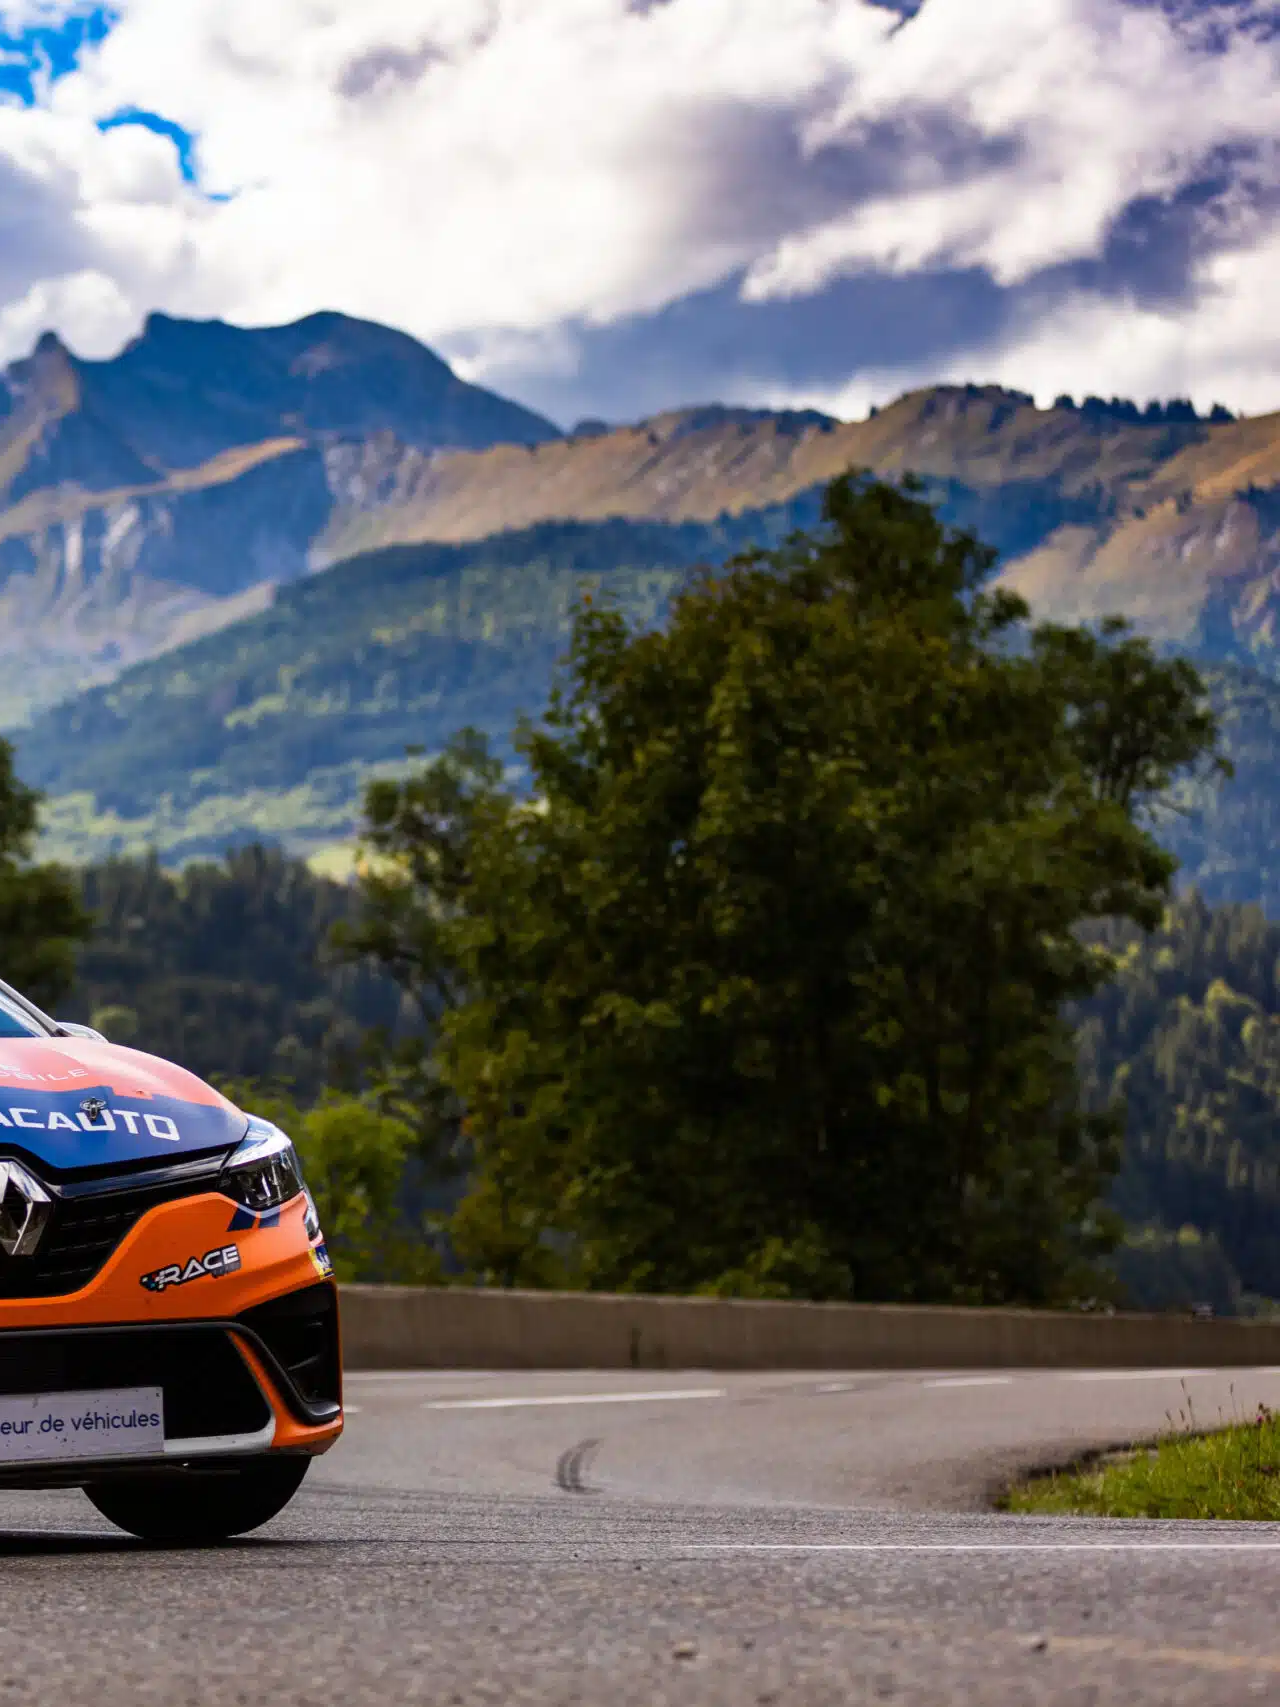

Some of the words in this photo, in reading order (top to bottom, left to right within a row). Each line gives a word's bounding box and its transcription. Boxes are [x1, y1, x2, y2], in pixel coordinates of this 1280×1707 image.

[155, 1246, 240, 1288] RACE
[40, 1413, 65, 1432] de
[71, 1410, 161, 1430] véhicules
